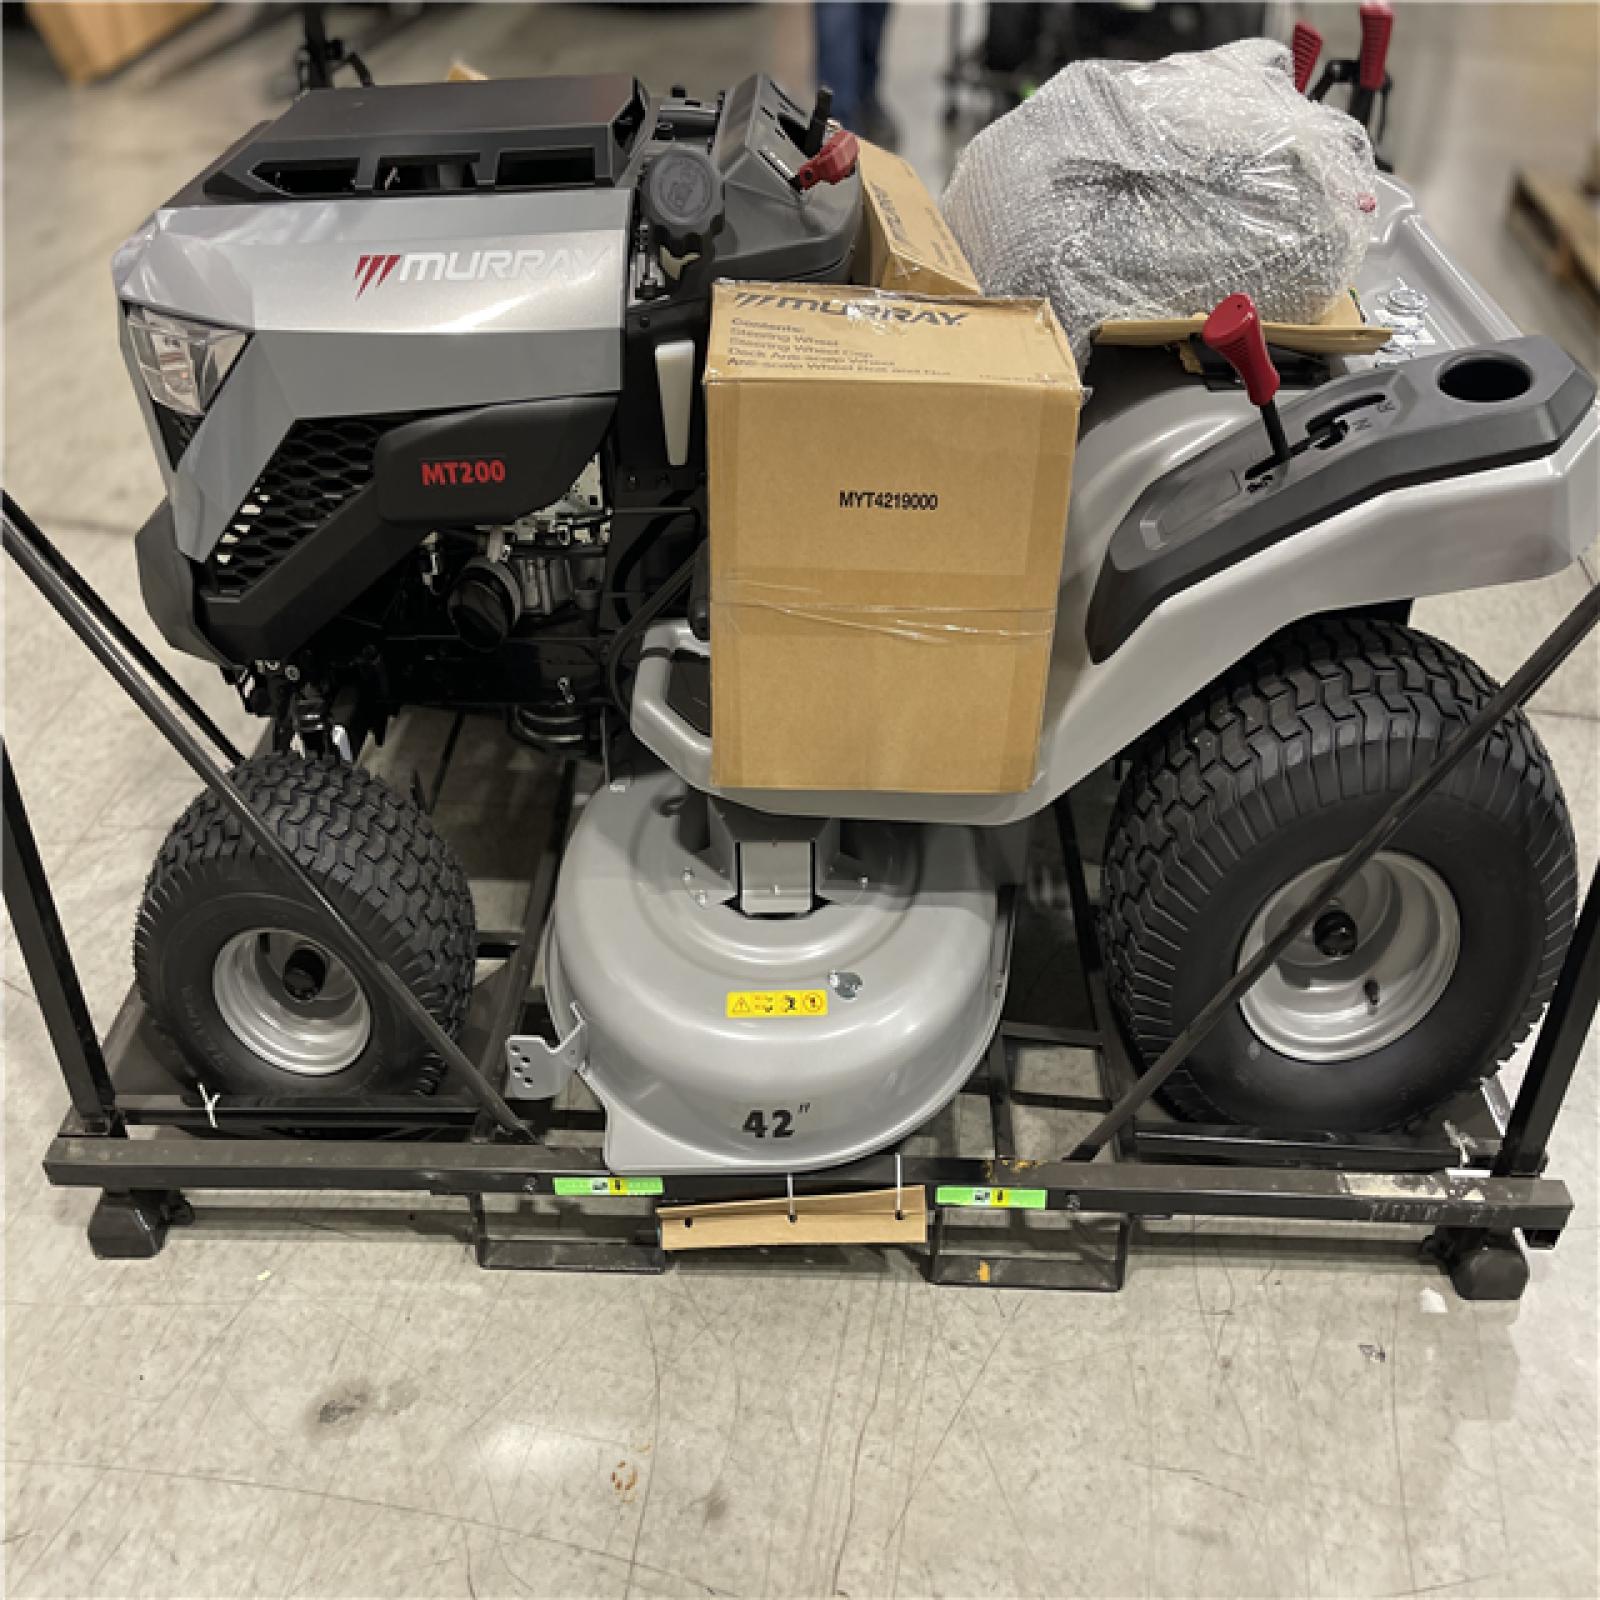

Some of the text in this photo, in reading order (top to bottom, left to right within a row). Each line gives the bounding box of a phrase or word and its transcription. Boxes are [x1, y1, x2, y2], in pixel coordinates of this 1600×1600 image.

[399, 250, 611, 281] MURRAY
[421, 460, 506, 486] MT200
[839, 490, 938, 510] MYT4219000
